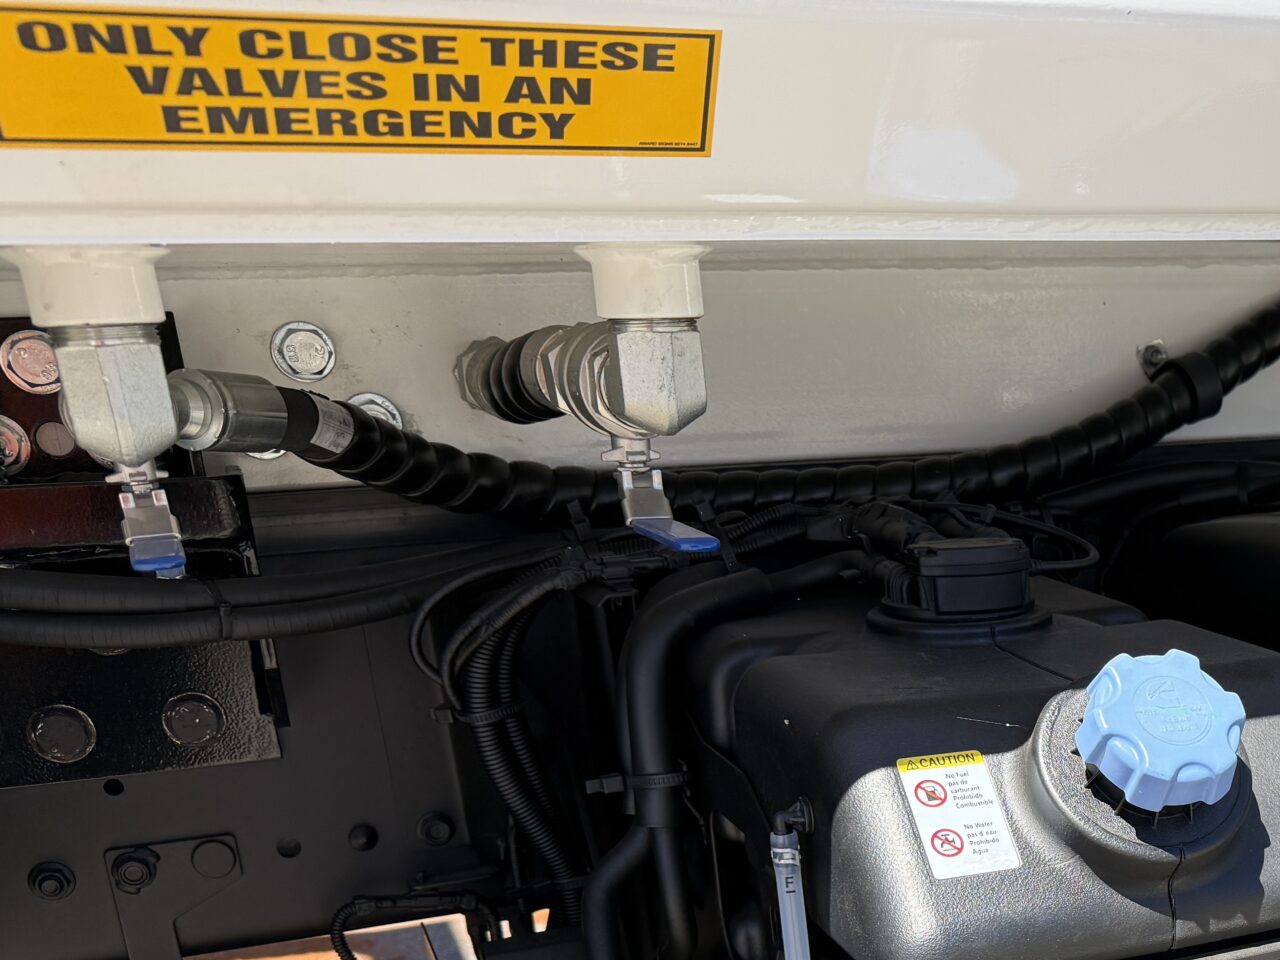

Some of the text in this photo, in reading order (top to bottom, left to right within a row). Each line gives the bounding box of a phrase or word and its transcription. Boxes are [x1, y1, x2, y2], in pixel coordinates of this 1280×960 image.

[16, 21, 677, 73] ONLY CLOSE THESE
[125, 65, 592, 106] VALVES IN AN
[161, 105, 576, 140] EMERGENCY
[920, 753, 976, 768] CAUTION
[951, 786, 981, 794] carburant
[953, 793, 983, 801] Prohibido
[956, 799, 993, 809] Combustible
[970, 838, 1000, 846] Prohibido
[973, 848, 989, 856] Agua
[785, 876, 794, 888] F
